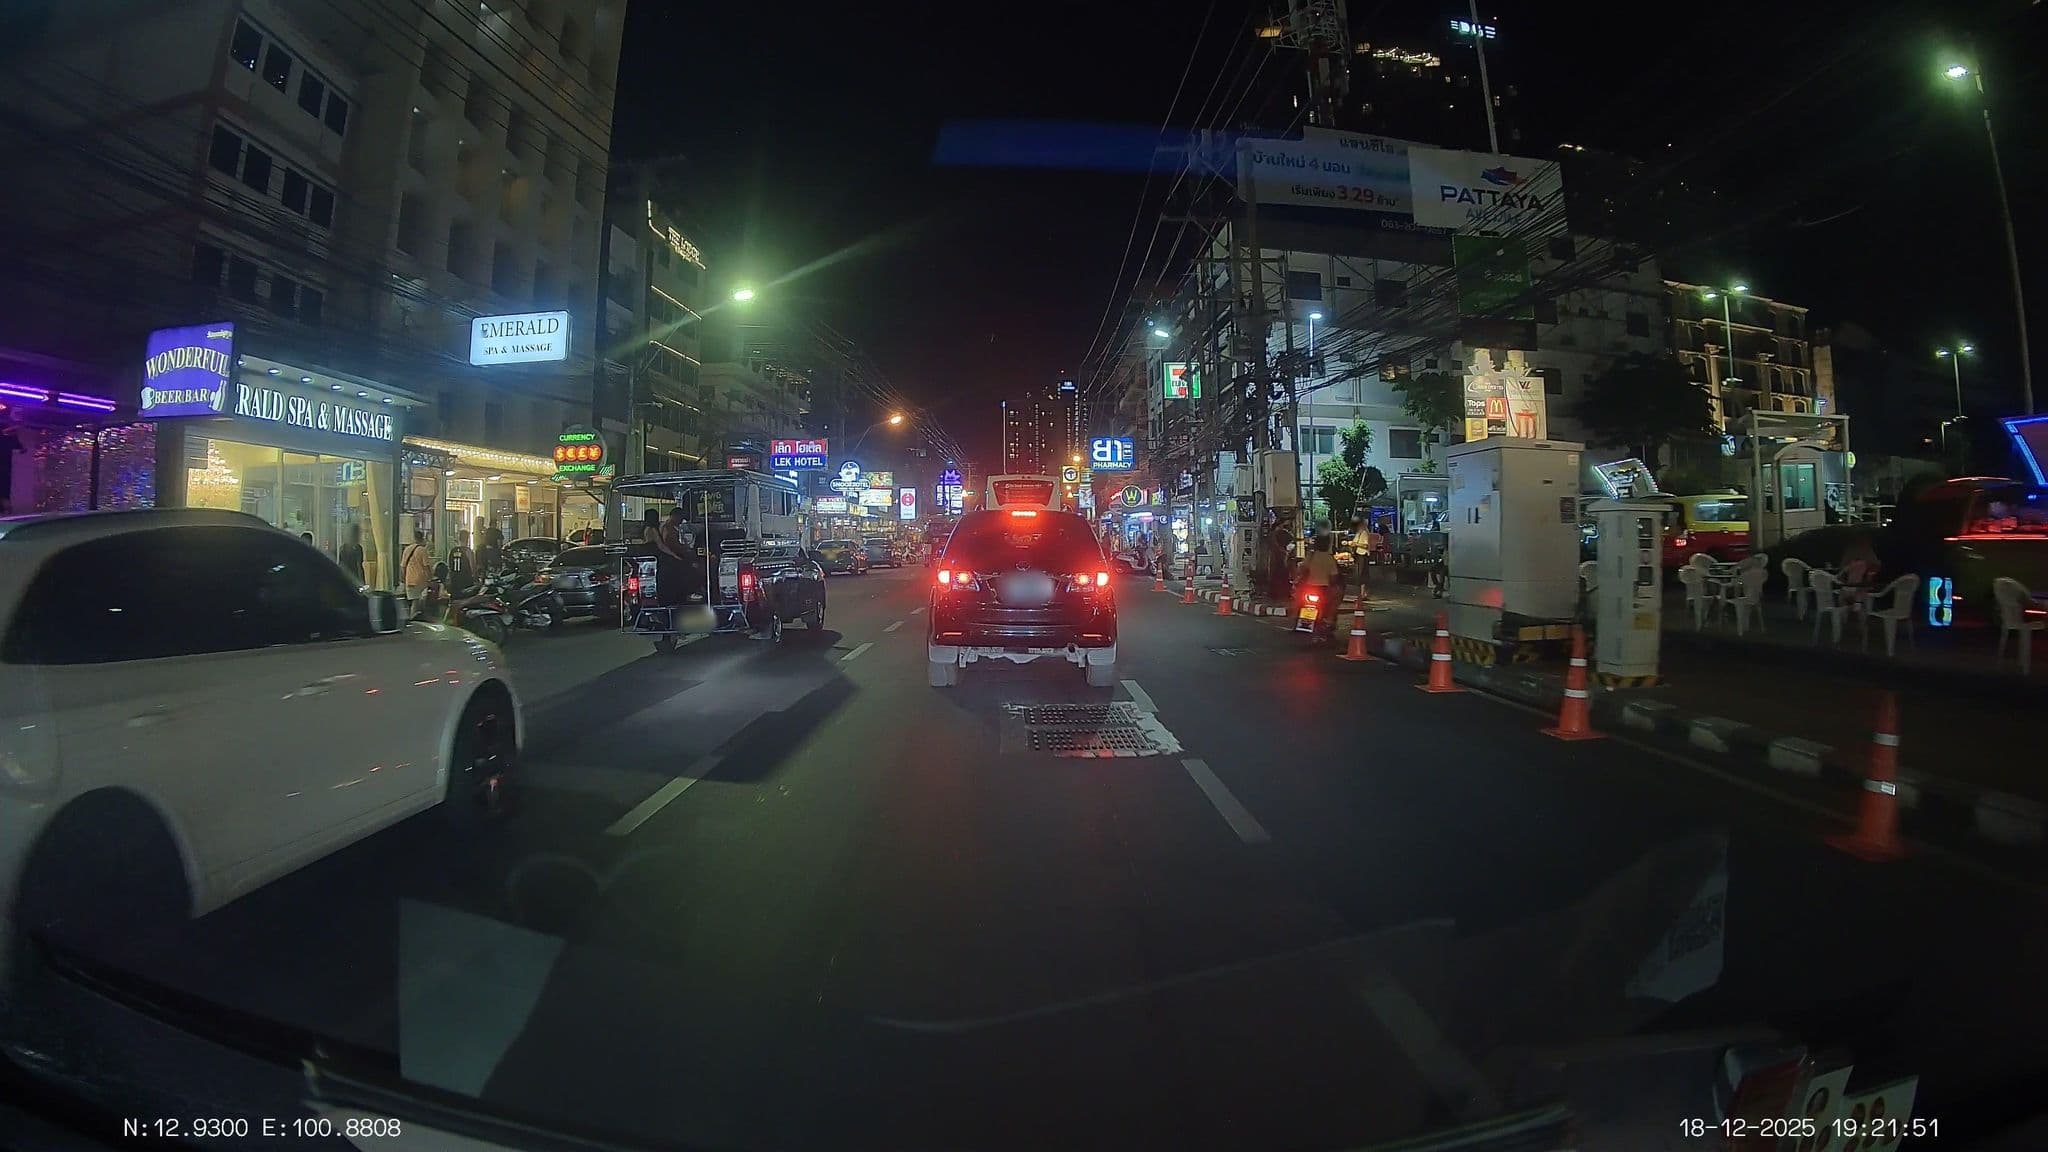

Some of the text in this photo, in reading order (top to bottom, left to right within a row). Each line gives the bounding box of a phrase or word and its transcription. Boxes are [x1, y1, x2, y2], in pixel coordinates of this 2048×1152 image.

[1440, 185, 1545, 212] PATTAYA
[481, 317, 560, 338] EMERALD
[511, 342, 553, 354] MASSAGE
[145, 346, 231, 379] WONDERFUL
[154, 388, 208, 404] BEER BAR
[1467, 399, 1486, 408] Tops
[235, 383, 393, 441] RALD SPA & MASSAGE
[559, 433, 596, 441] CURRENCY
[774, 456, 824, 467] LEK HOTEL
[1093, 461, 1132, 469] PHARMACY
[559, 464, 596, 472] EXCHANGE
